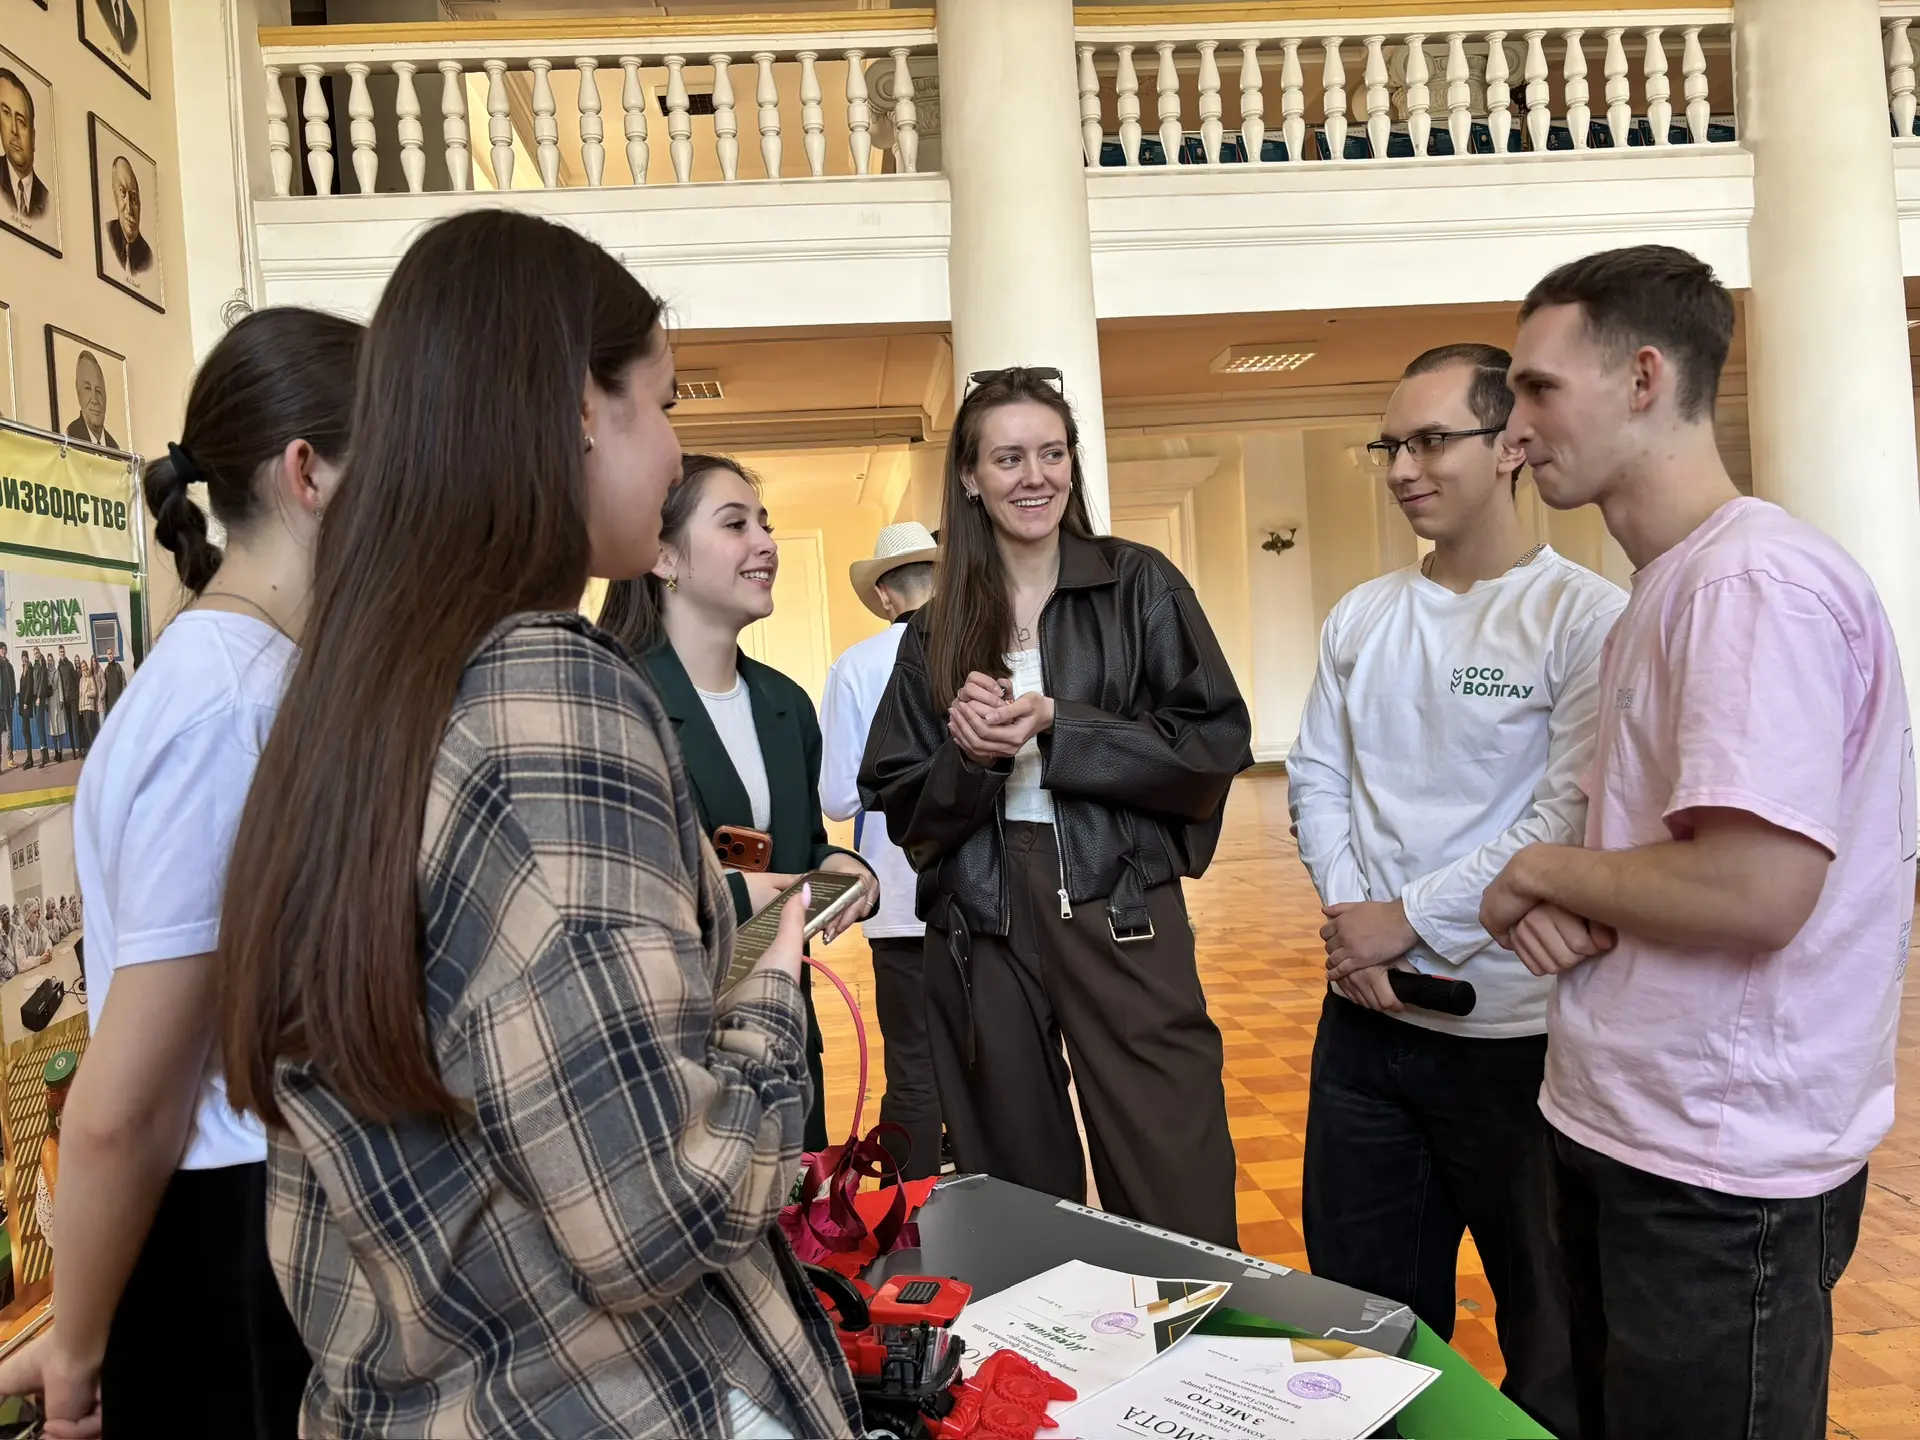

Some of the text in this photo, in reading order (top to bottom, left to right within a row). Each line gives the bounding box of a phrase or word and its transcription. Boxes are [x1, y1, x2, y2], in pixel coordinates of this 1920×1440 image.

[0, 477, 126, 531] изводстве
[23, 597, 83, 619] EKONIVA
[15, 616, 80, 637] ЭКОНИВА
[1465, 666, 1504, 682] ОСО
[1462, 681, 1535, 699] ВОЛГАУ
[1187, 1393, 1265, 1426] 3 МЕСТО
[1220, 1418, 1265, 1438] КОМАНДА
